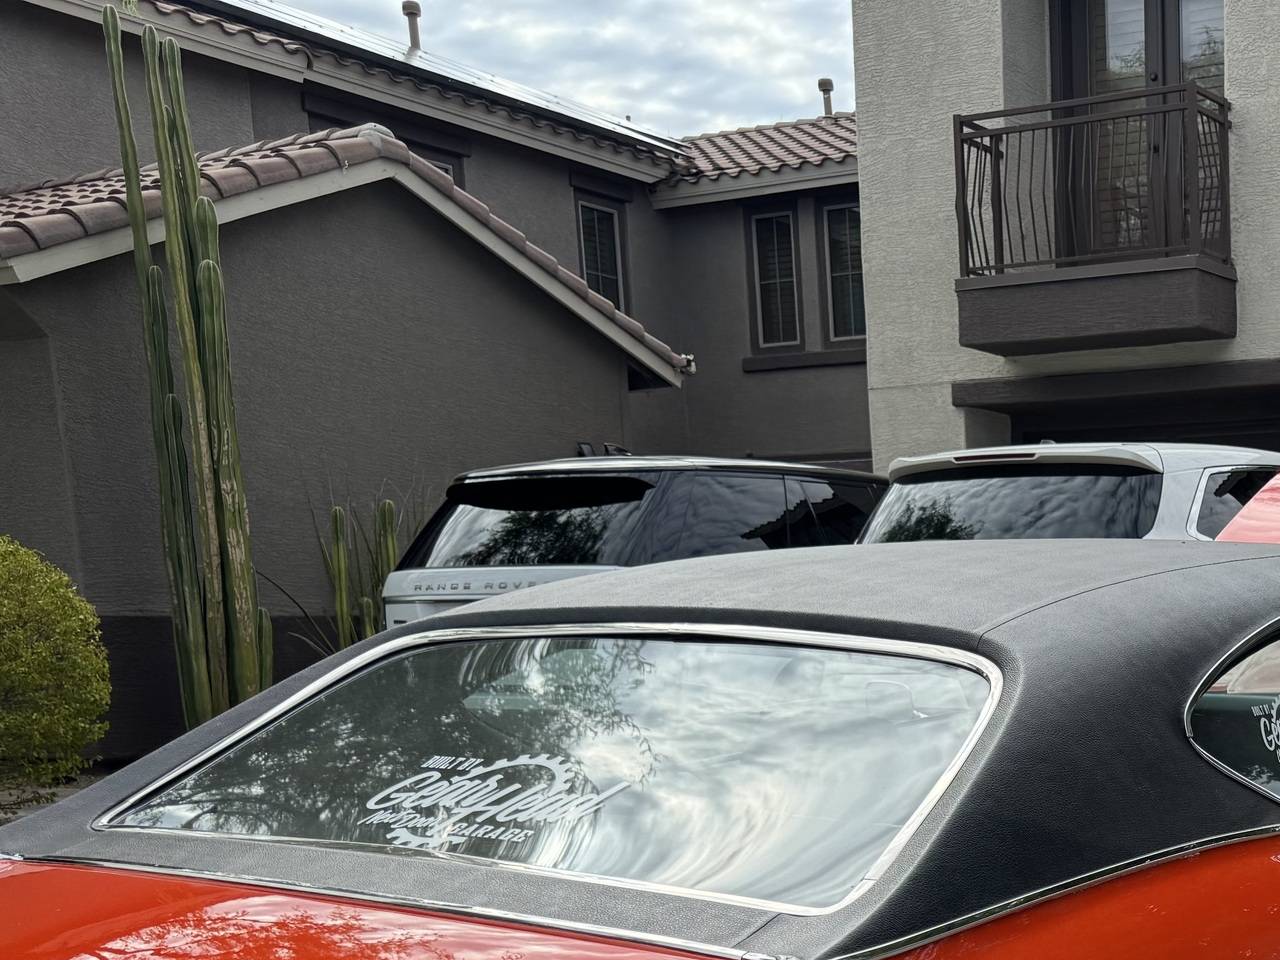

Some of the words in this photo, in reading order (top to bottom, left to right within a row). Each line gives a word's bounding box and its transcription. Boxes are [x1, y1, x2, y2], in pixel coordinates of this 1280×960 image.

[414, 583, 472, 592] RANGE
[484, 581, 552, 590] ROVE
[421, 755, 467, 770] BUILT
[456, 757, 485, 771] BY
[425, 781, 632, 836] Head
[450, 822, 535, 843] GARAGE
